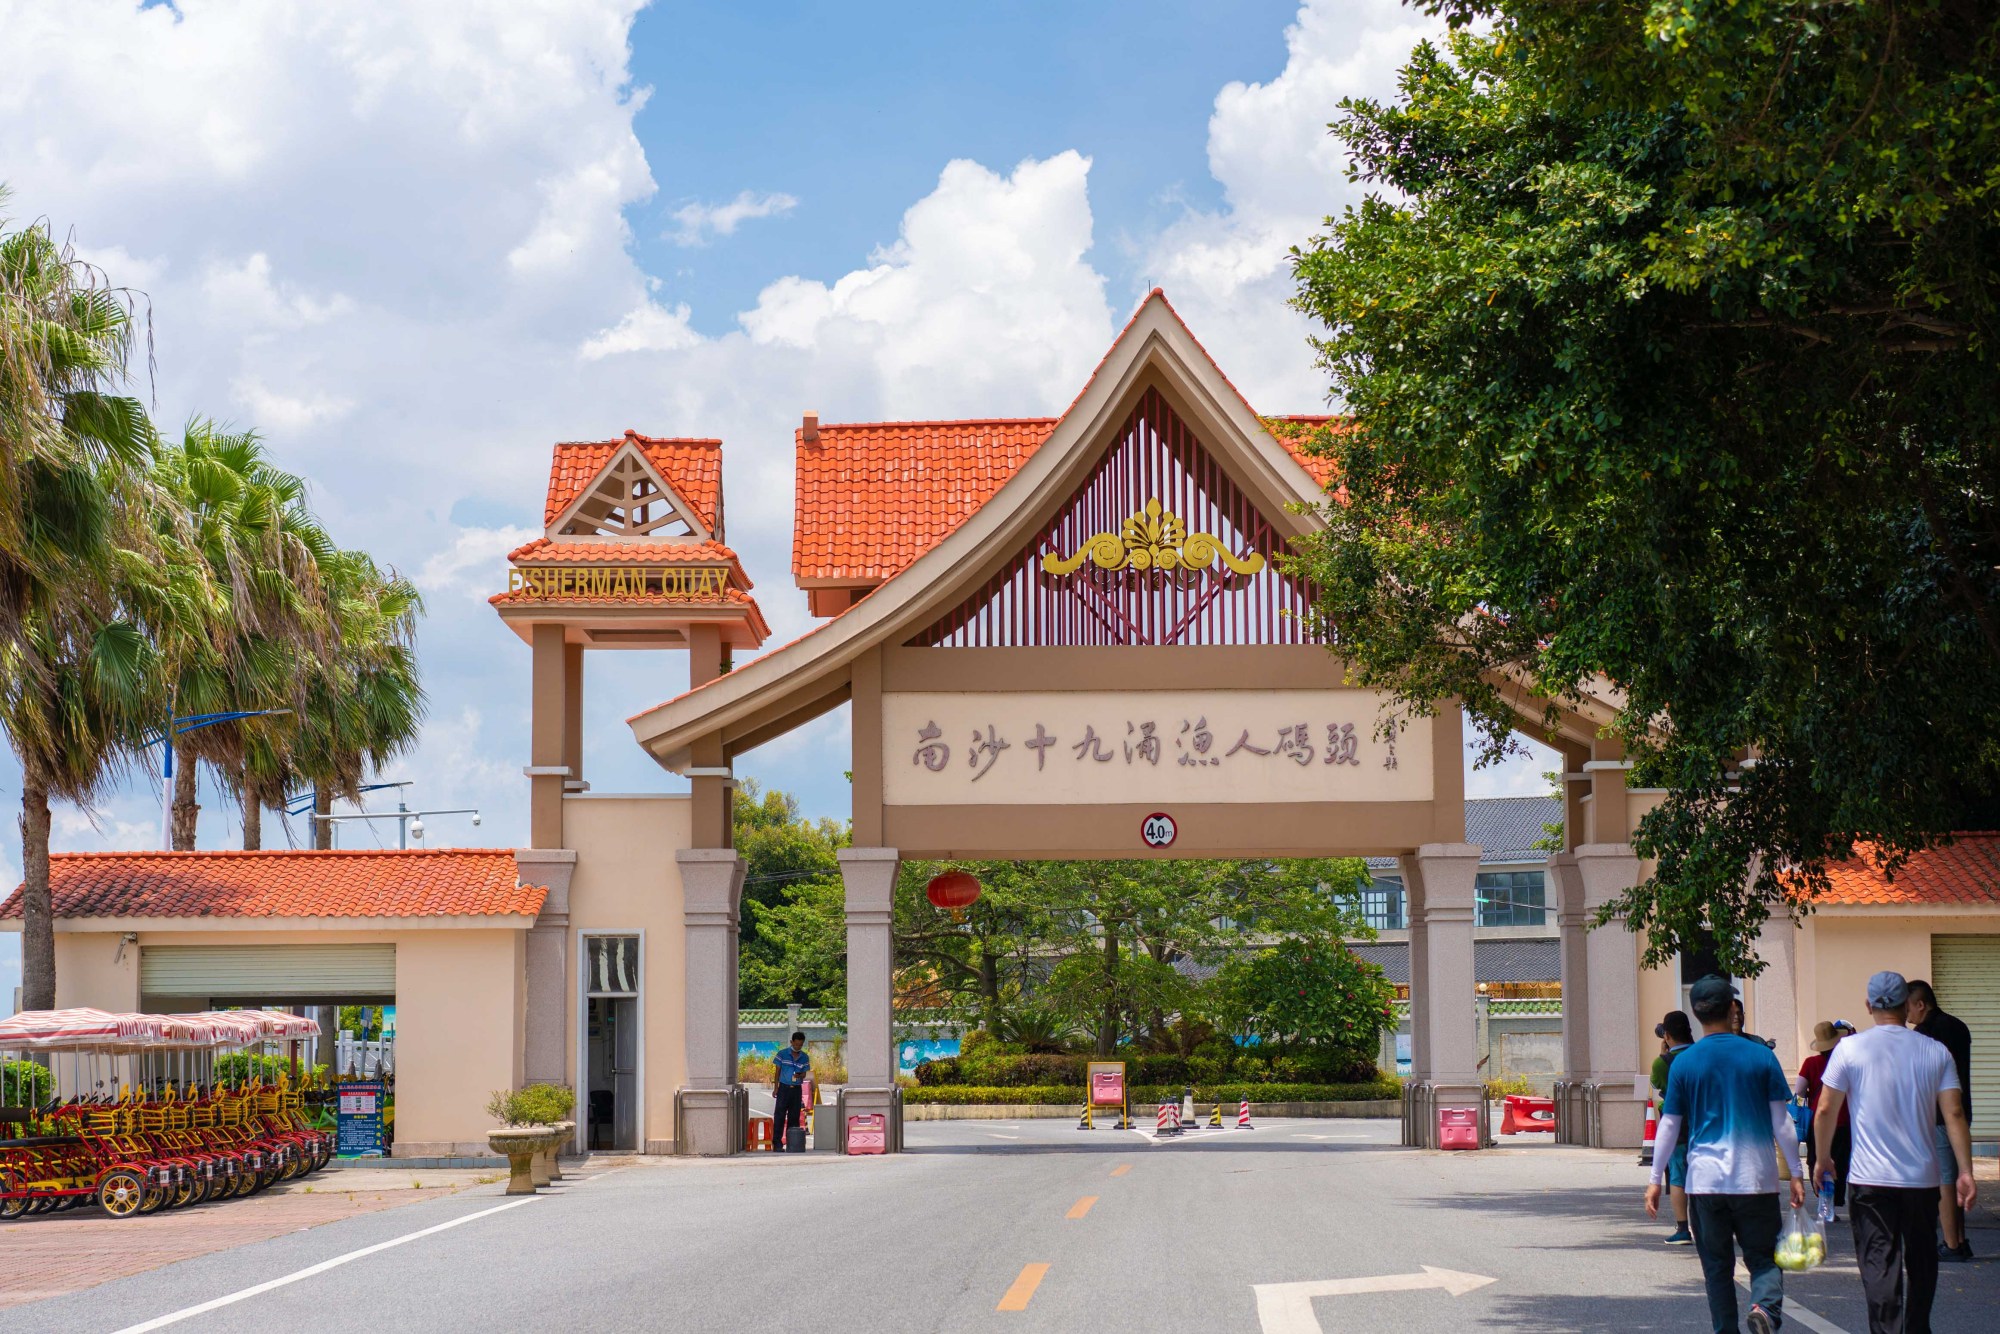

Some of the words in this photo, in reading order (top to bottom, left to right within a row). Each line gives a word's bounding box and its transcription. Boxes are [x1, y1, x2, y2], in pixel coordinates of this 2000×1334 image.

[508, 568, 646, 598] FISHERMAN
[662, 568, 729, 598] QUAY
[1146, 822, 1173, 839] 4.0m
